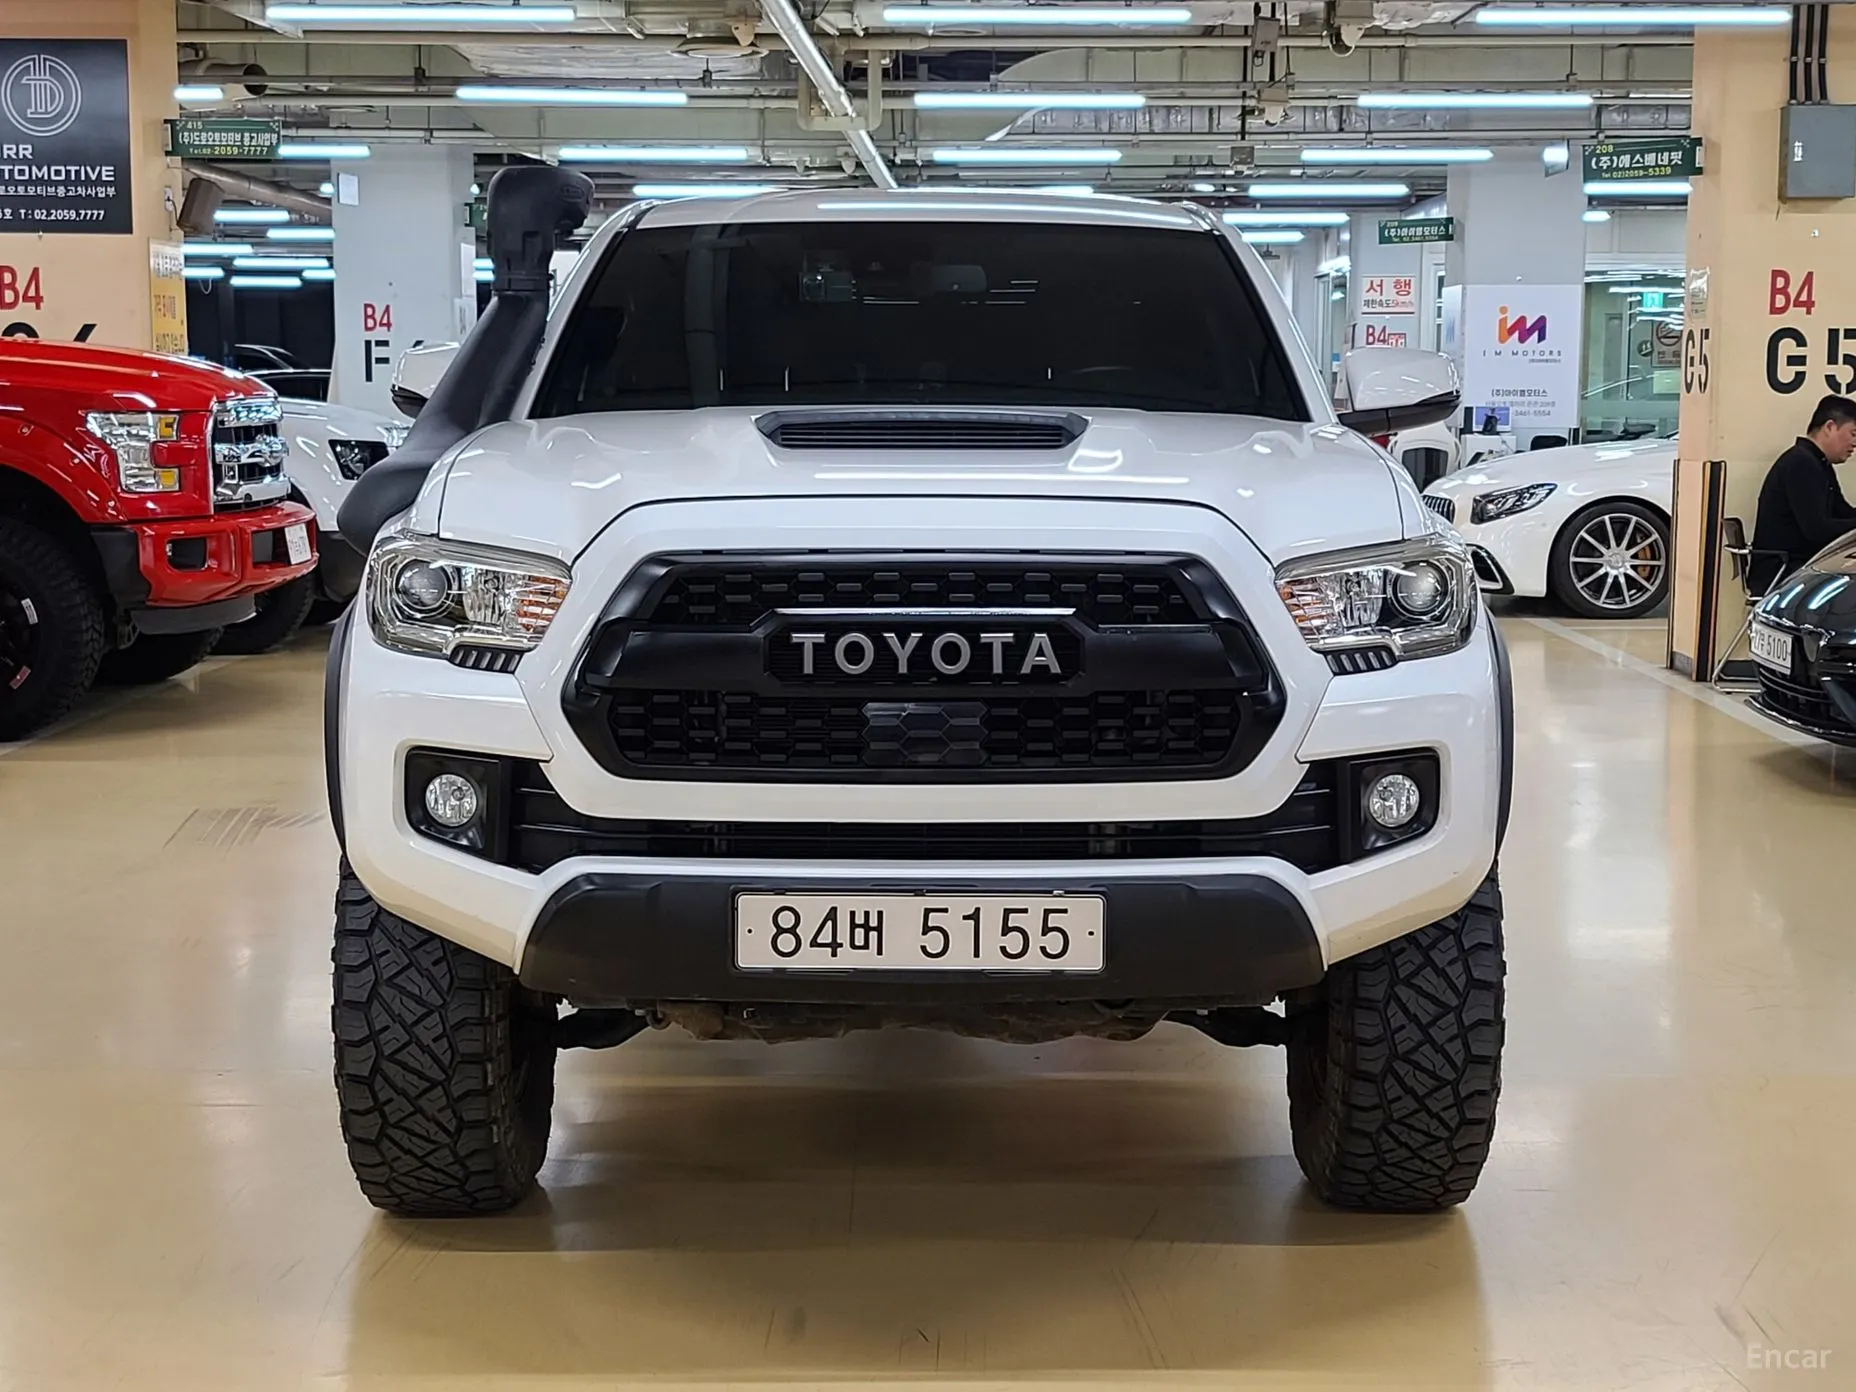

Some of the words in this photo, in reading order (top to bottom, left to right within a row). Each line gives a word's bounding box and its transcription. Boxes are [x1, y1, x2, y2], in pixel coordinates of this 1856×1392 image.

[1591, 151, 1683, 170] (주)에스베네핏
[1595, 145, 1614, 154] 208
[0, 165, 115, 181] TOMOTIVE
[0, 265, 44, 310] B4
[1769, 269, 1815, 315] B4
[363, 303, 393, 332] B4
[1366, 324, 1387, 346] B4
[1684, 328, 1710, 394] G5
[791, 633, 1062, 675] TOYOTA
[770, 905, 884, 958] 84버
[919, 906, 1070, 960] 5155
